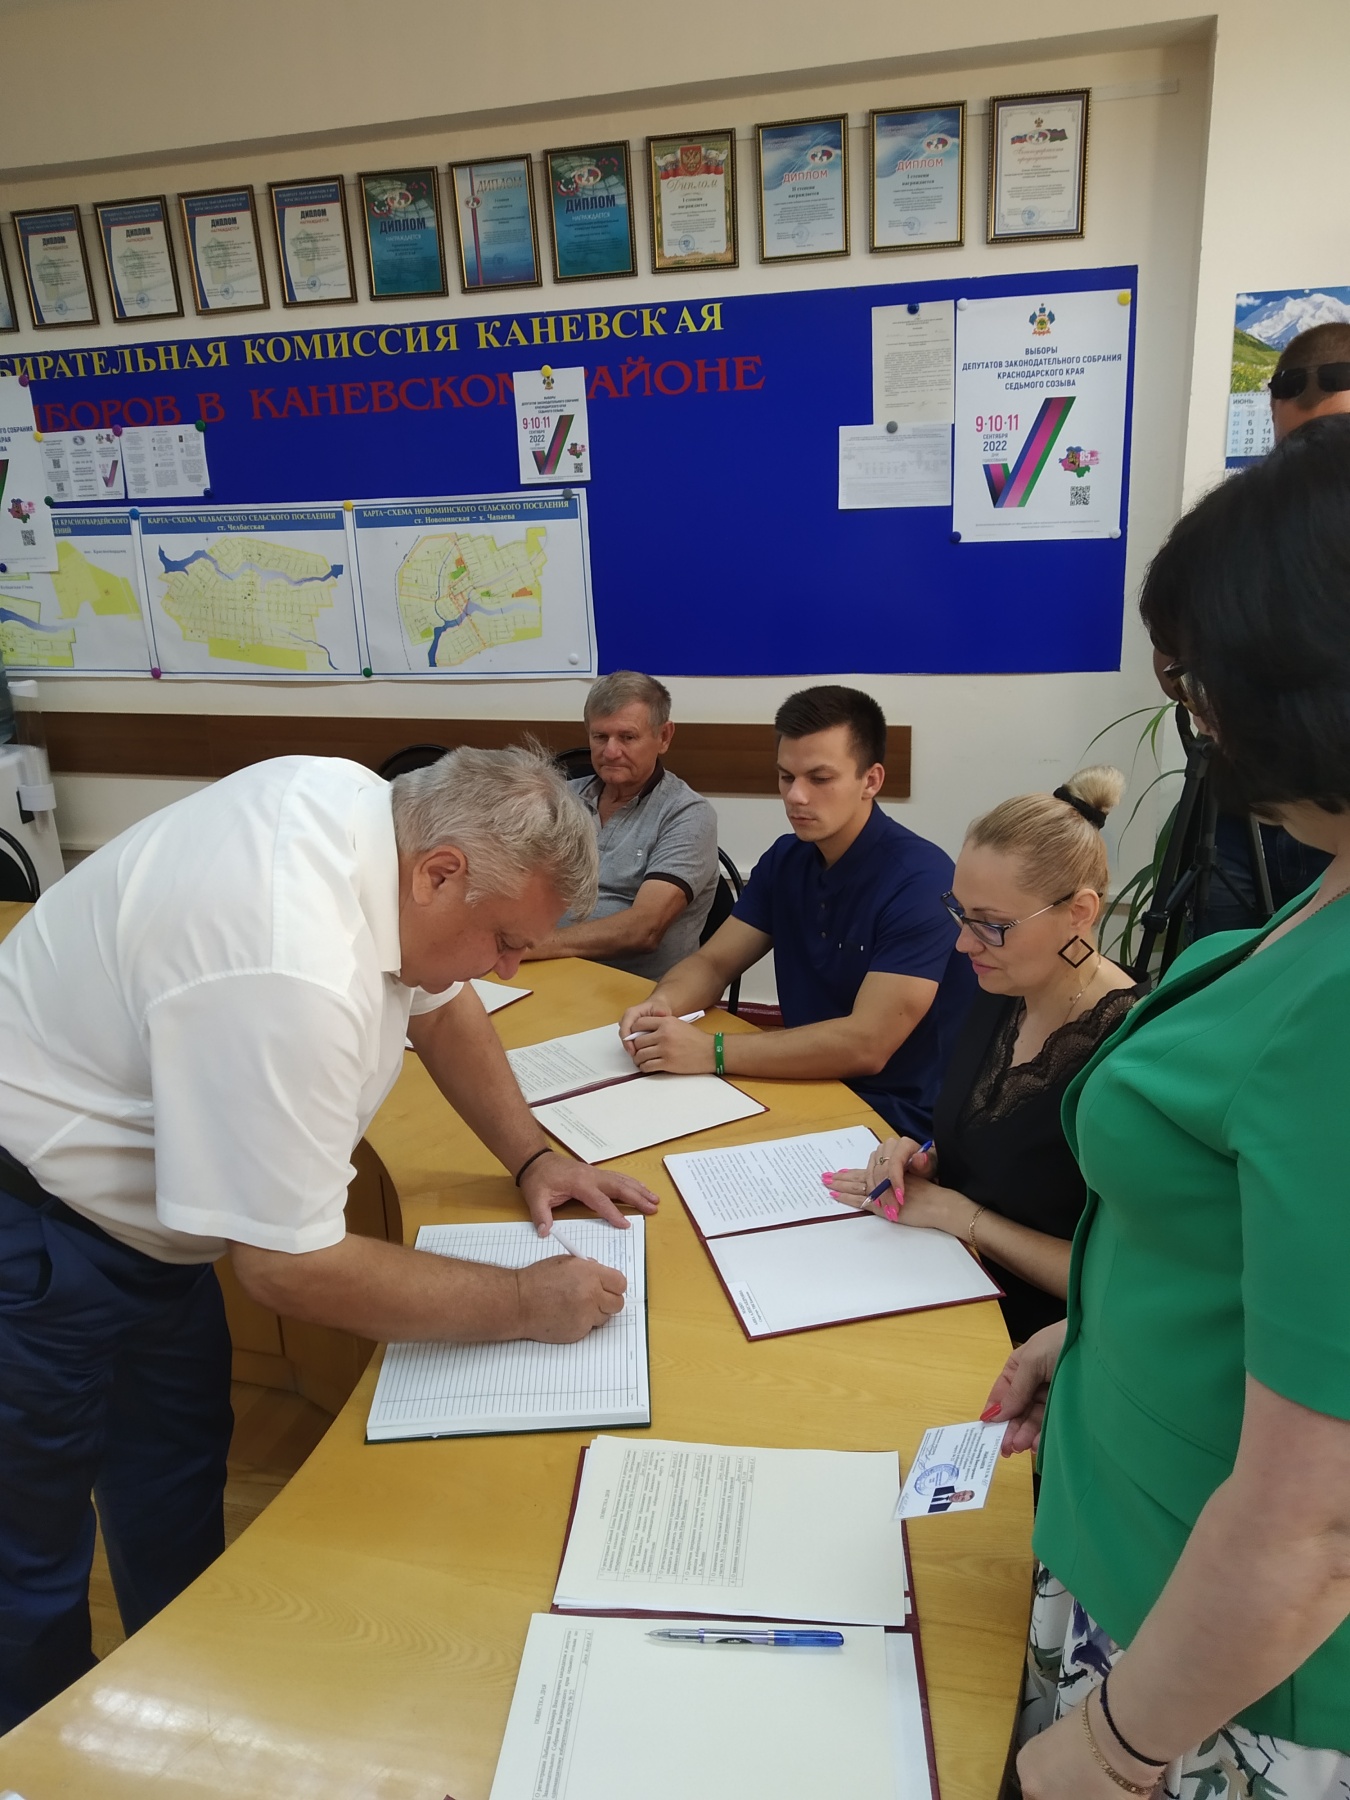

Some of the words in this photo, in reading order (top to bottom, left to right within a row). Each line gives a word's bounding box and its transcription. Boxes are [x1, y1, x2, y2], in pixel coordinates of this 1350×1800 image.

[895, 158, 944, 172] ДИПЛОМ
[782, 170, 828, 184] ДИПЛОМ
[476, 176, 524, 195] ДИПЛОМ
[565, 194, 616, 214] ДИПЛОМ
[300, 208, 327, 220] ДИПЛОМ
[210, 216, 238, 228] ДИПЛОМ
[379, 217, 427, 235] ДИПЛОМ
[243, 324, 459, 366] КОМИССИЯ
[1024, 346, 1058, 356] ВЫБОРЫ
[961, 361, 1003, 371] ДЕПУТАТОВ
[1004, 356, 1081, 368] ЗАКОНОДАТЕЛЬНОГО
[1082, 353, 1122, 363] СОБРАНИЯ
[997, 369, 1064, 380] КРАСНОДАРСКОГО
[1065, 367, 1085, 375] КРАЯ
[1004, 381, 1044, 390] СЕДЬМОГО
[1045, 379, 1076, 387] СОЗЫВА
[33, 395, 182, 433] БОРОВ
[196, 392, 226, 423] В
[583, 355, 766, 399] АЙОНЕ
[529, 435, 545, 443] 2022
[982, 440, 1007, 452] 2022
[414, 506, 476, 515] НОВОМИНСКОГО
[478, 503, 521, 512] СЕЛЬСКОГО
[522, 500, 569, 510] ПОСЕЛЕНИЯ
[291, 512, 336, 520] ПОСЕЛЕНИЯ
